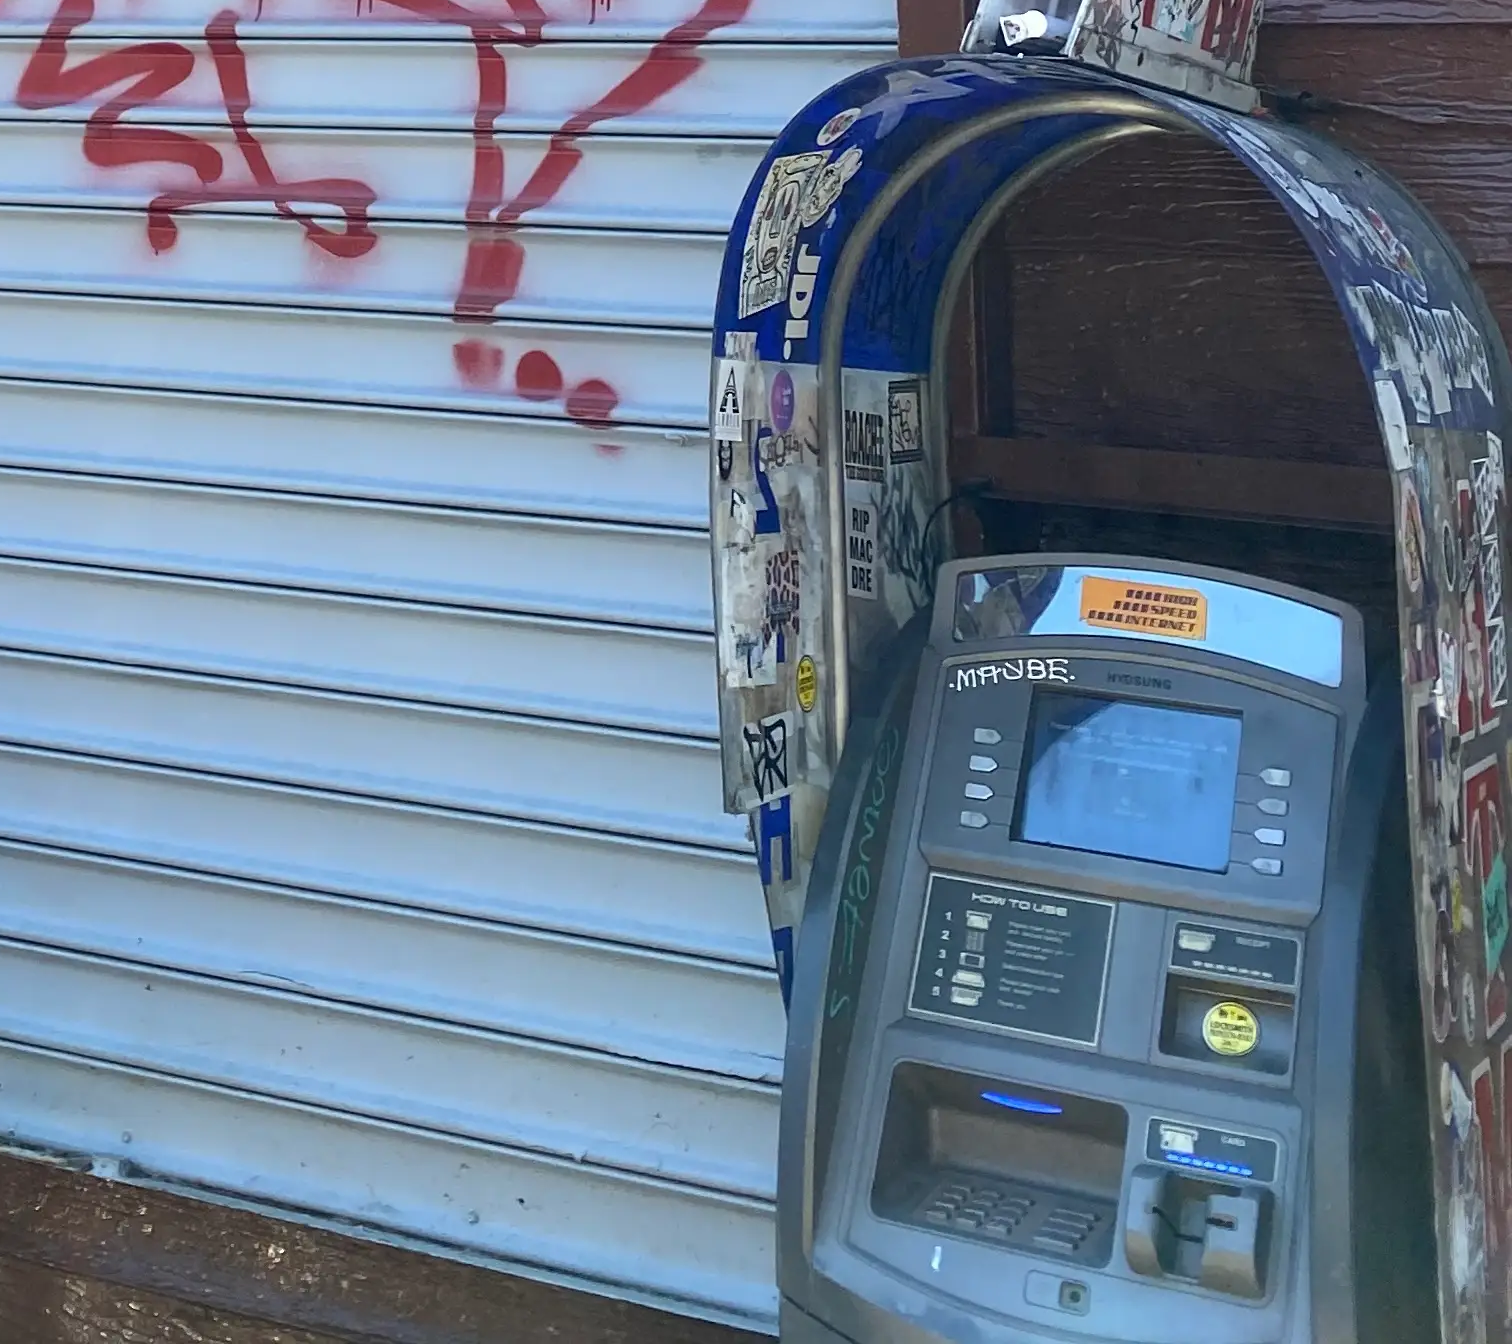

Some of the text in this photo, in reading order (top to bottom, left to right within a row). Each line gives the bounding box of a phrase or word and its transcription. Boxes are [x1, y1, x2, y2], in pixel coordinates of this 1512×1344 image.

[852, 508, 870, 533] RIP
[850, 536, 873, 563] MAC
[851, 566, 872, 592] DRE
[1163, 593, 1199, 607] HIGH
[1150, 605, 1198, 620] SPEED
[1124, 615, 1197, 633] INTERNET
[1107, 671, 1172, 690] HYOSUNG
[971, 892, 1068, 917] HOW TO USE
[940, 930, 950, 941] 2
